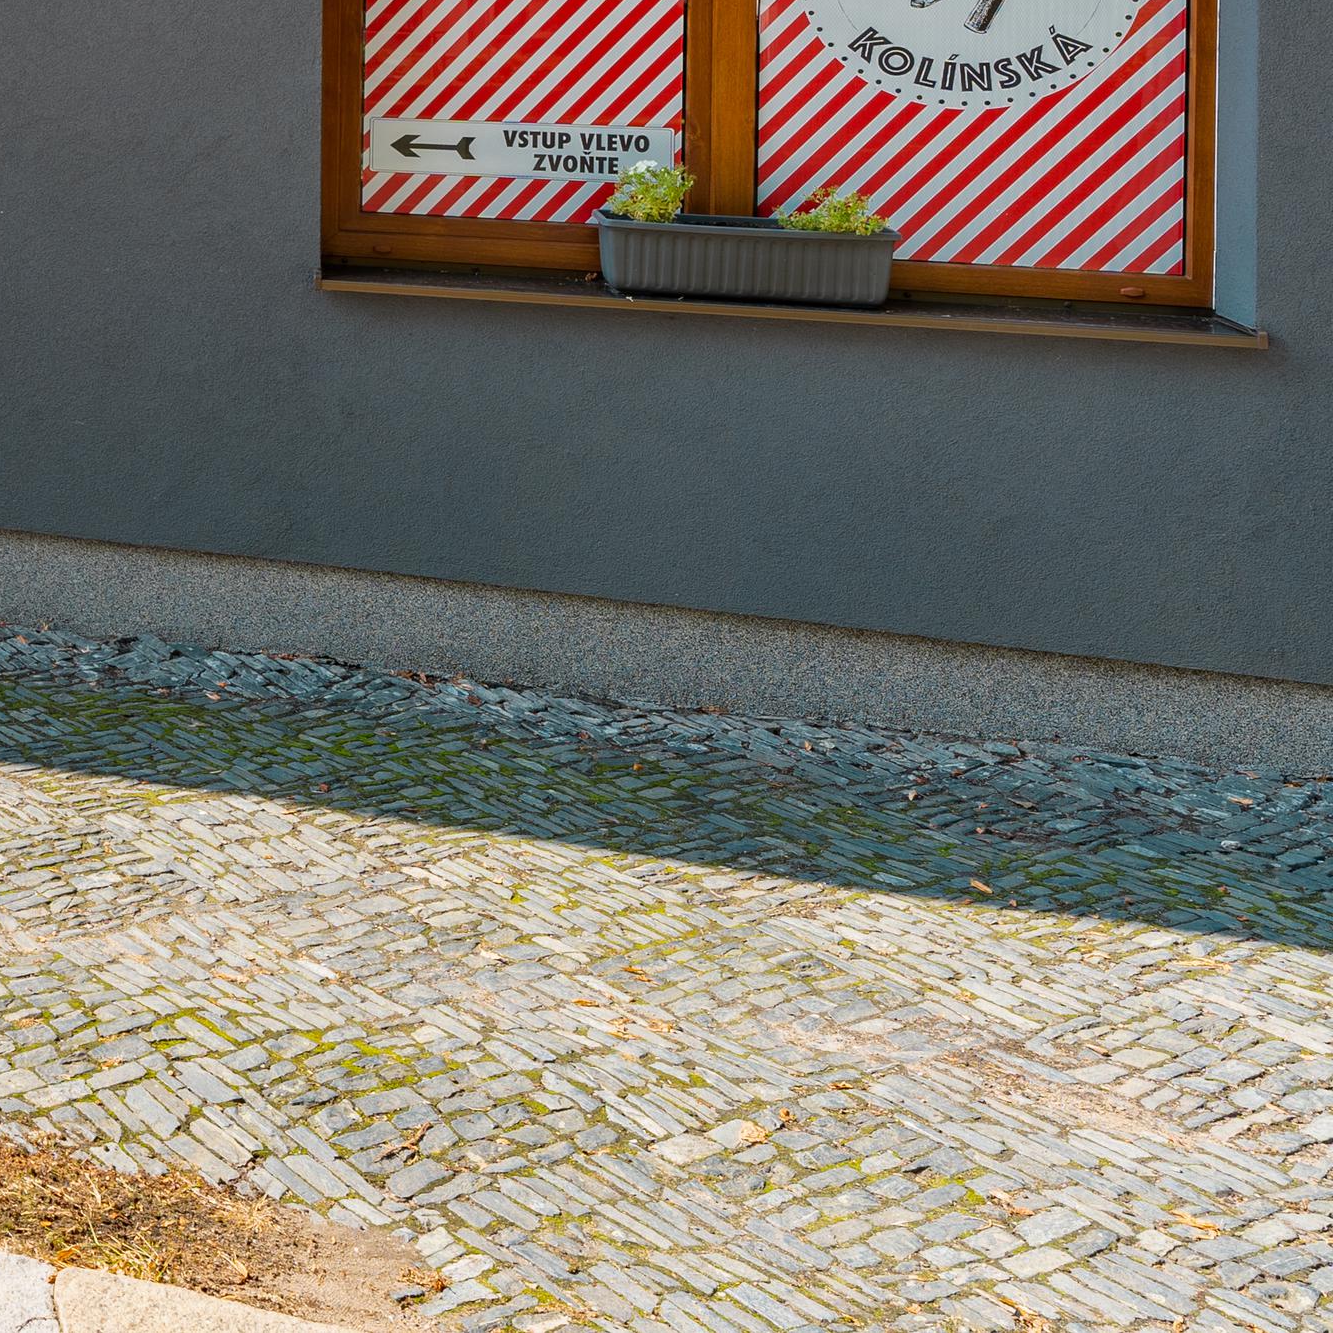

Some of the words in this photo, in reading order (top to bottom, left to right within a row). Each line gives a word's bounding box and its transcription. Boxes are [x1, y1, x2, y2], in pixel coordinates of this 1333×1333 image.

[847, 25, 1094, 92] KOLÍNSKÁ
[503, 130, 572, 149] VSTUP
[580, 133, 650, 153] VLEVO
[532, 151, 619, 175] ZVOŇTE
